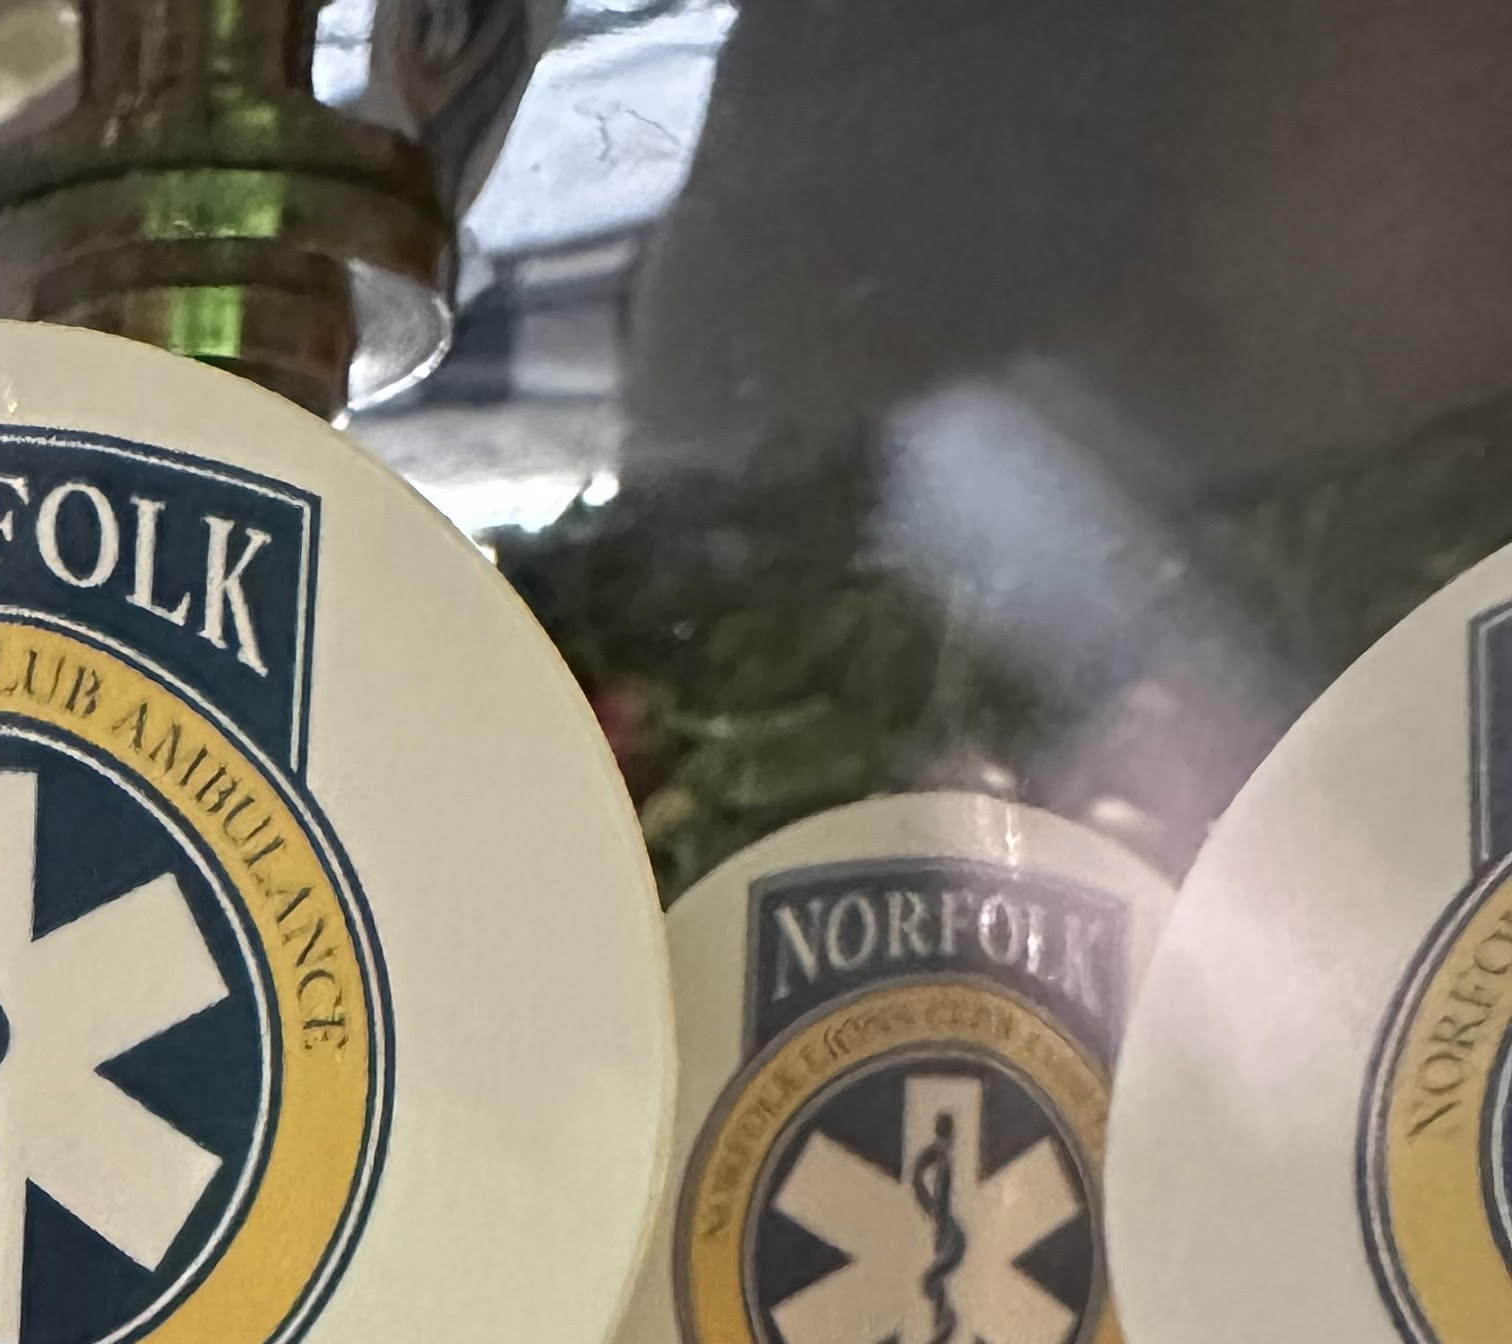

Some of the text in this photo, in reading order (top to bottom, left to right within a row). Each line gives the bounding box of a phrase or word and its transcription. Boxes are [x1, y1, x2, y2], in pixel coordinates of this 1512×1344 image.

[111, 701, 349, 1051] AMBULANCE
[772, 888, 1110, 1010] NORFOLK
[1406, 908, 1512, 1142] NORFO
